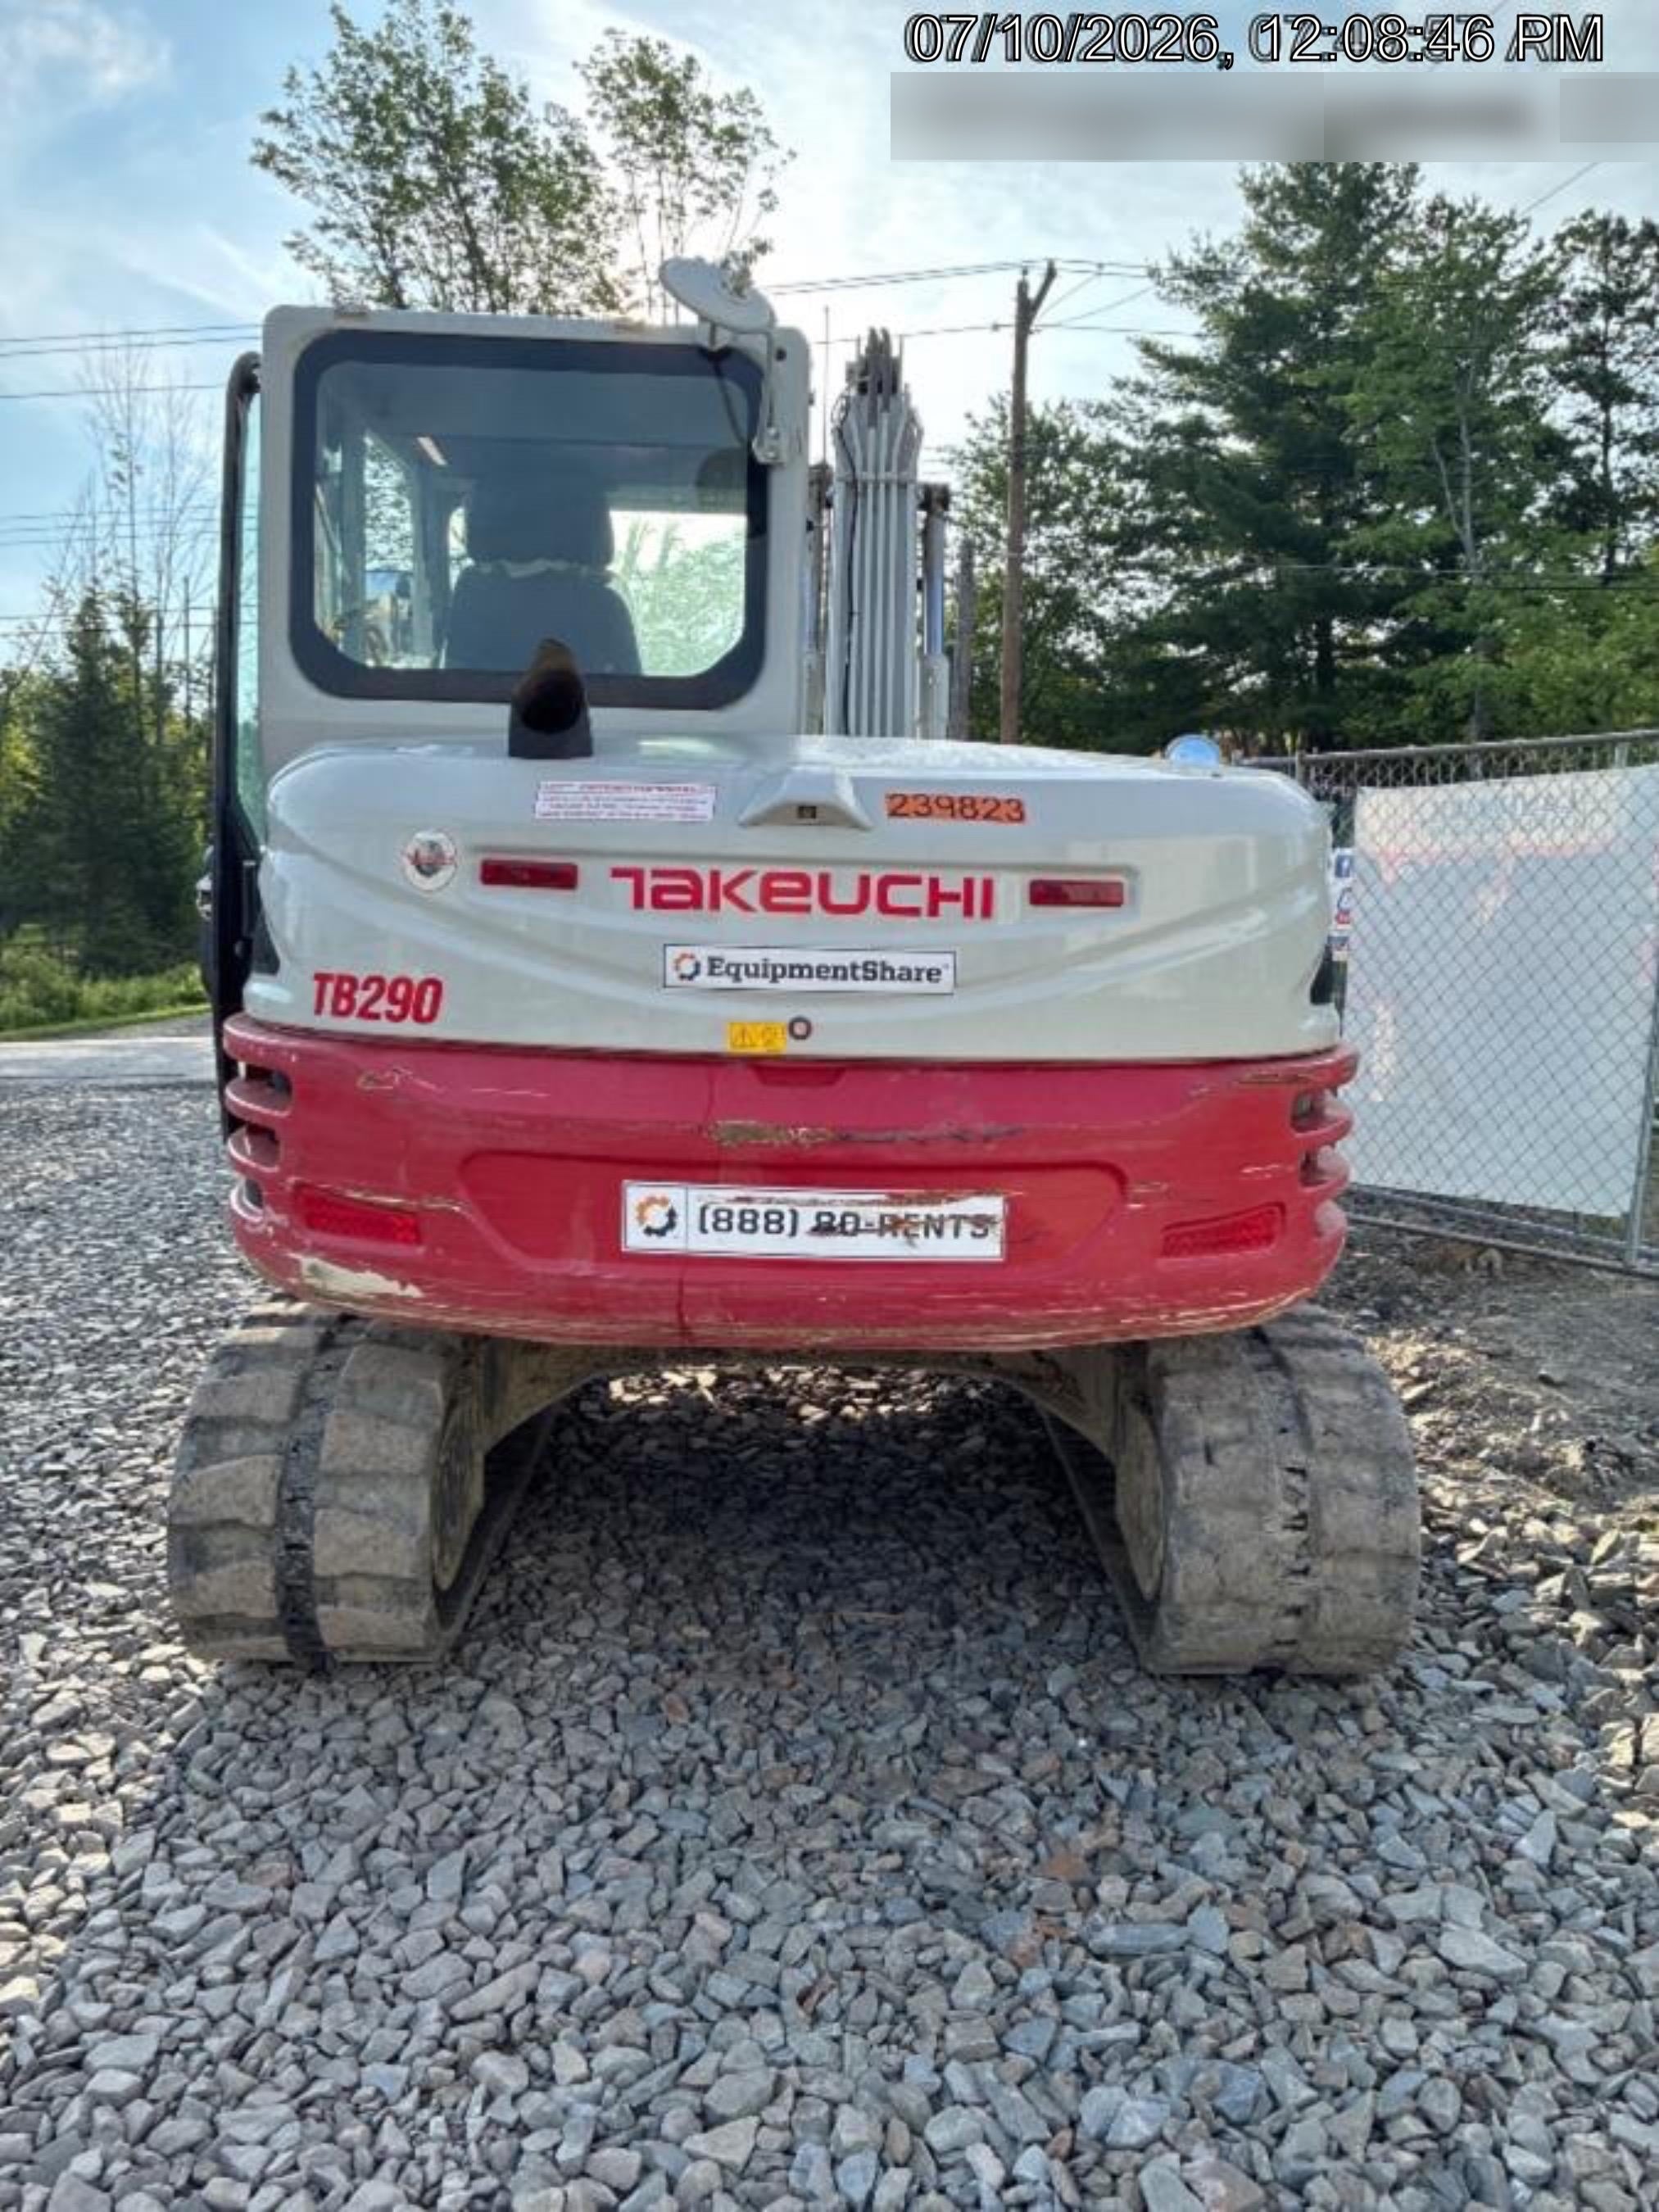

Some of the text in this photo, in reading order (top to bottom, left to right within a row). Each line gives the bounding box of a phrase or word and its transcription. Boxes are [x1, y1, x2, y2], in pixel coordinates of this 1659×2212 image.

[888, 792, 1026, 823] 239823
[706, 955, 944, 984] EquipmentShare
[313, 972, 443, 1024] TB290
[699, 1203, 799, 1238] (888)
